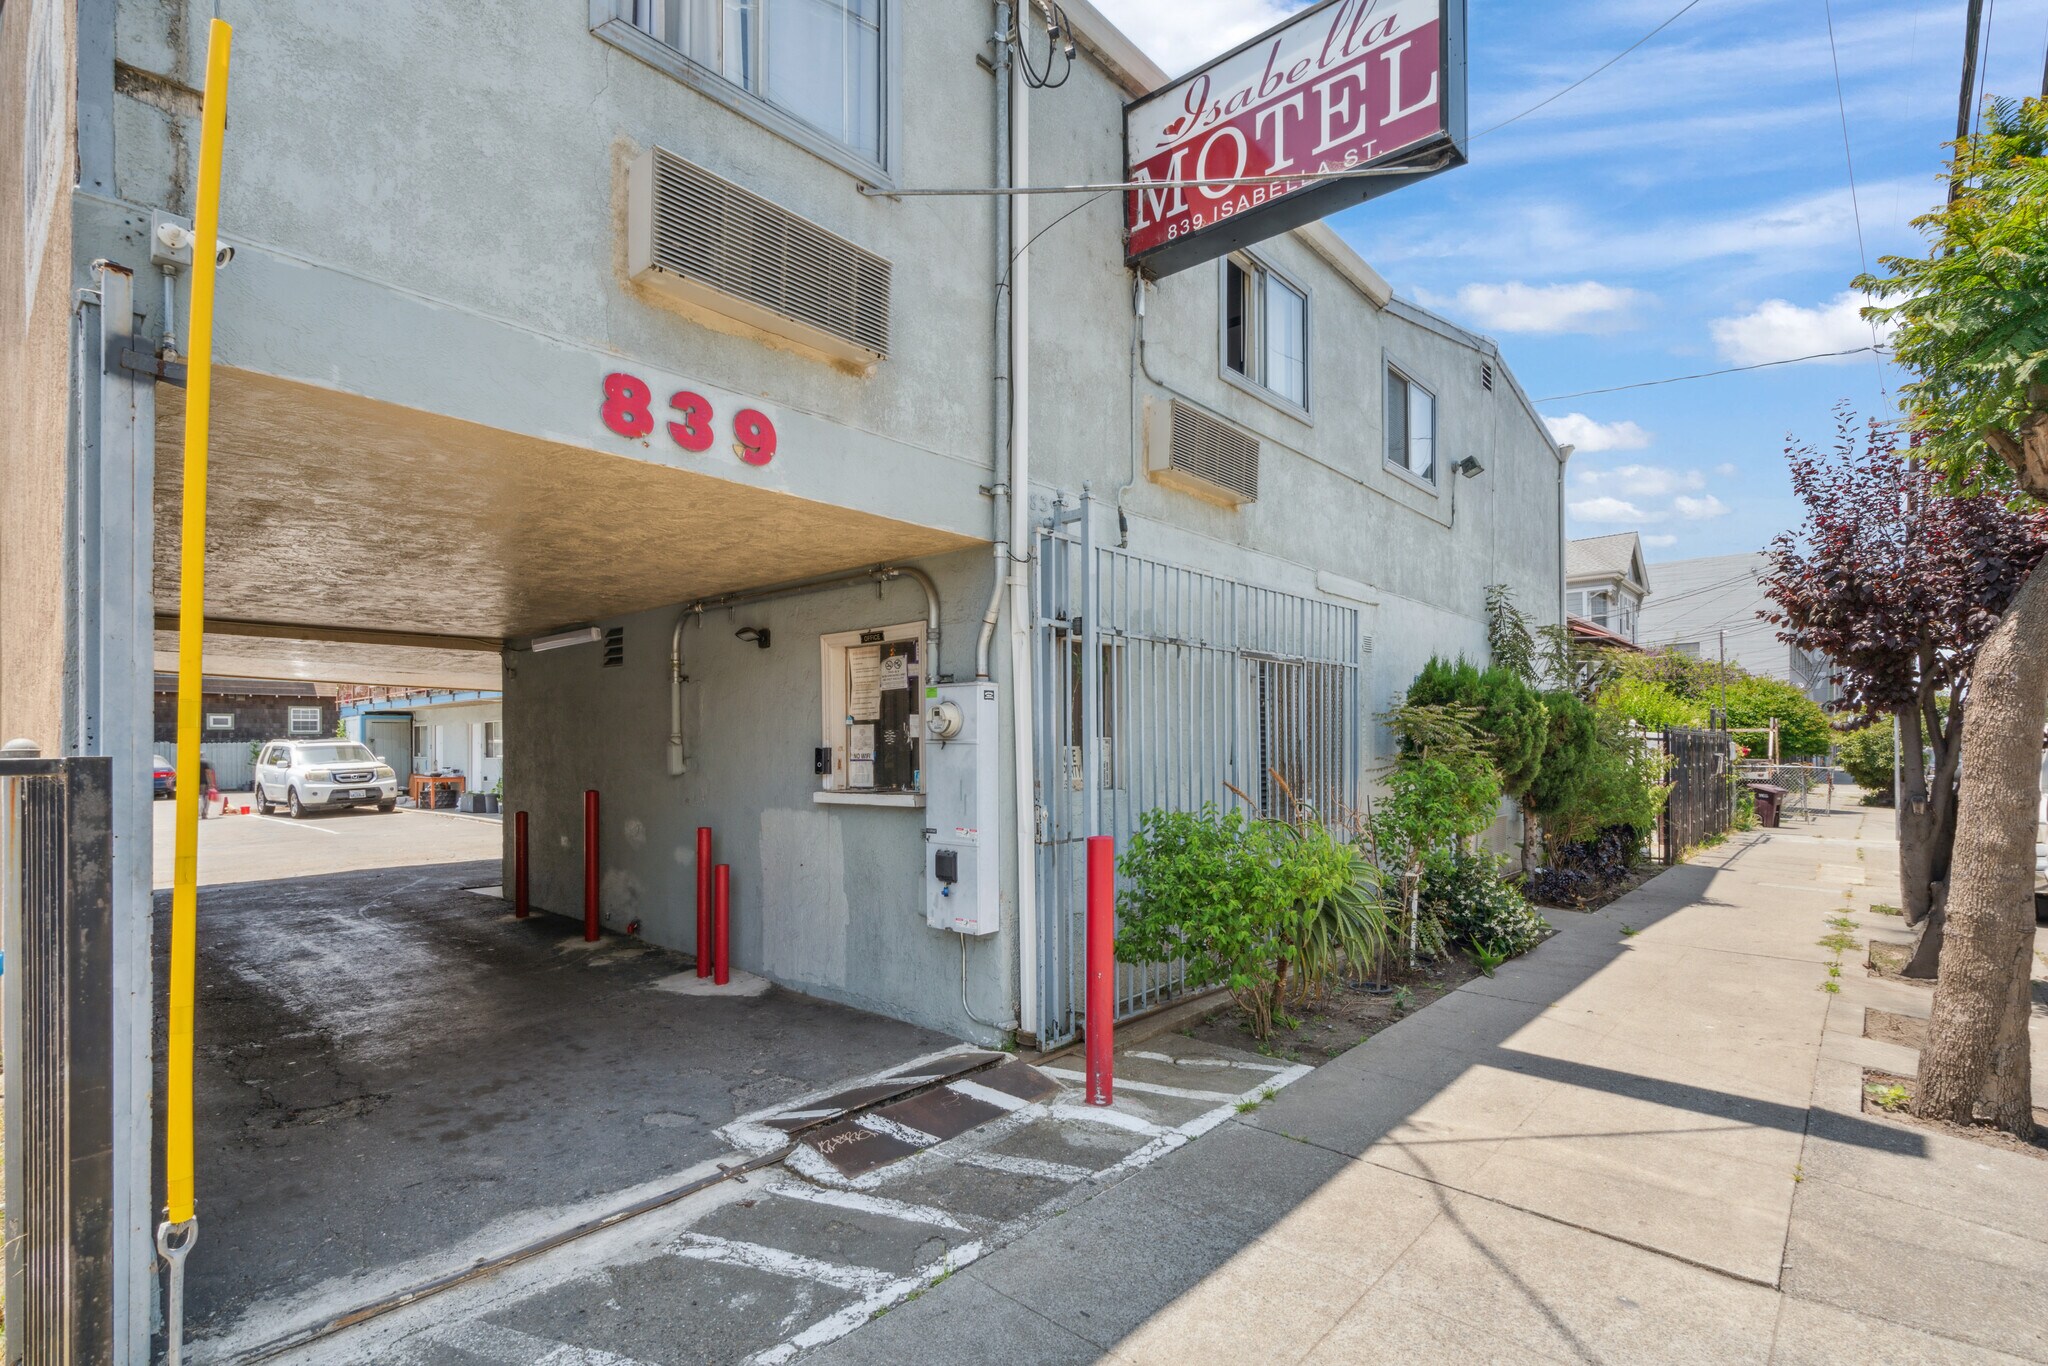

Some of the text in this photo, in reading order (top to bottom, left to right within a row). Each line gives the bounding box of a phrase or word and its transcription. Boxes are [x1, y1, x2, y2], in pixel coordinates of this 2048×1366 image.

[1156, 0, 1400, 148] Isabella
[1131, 40, 1438, 232] MOTEL
[1167, 140, 1383, 240] 839 ISABELLA ST.
[599, 372, 777, 467] 839
[863, 633, 881, 642] OFFICE
